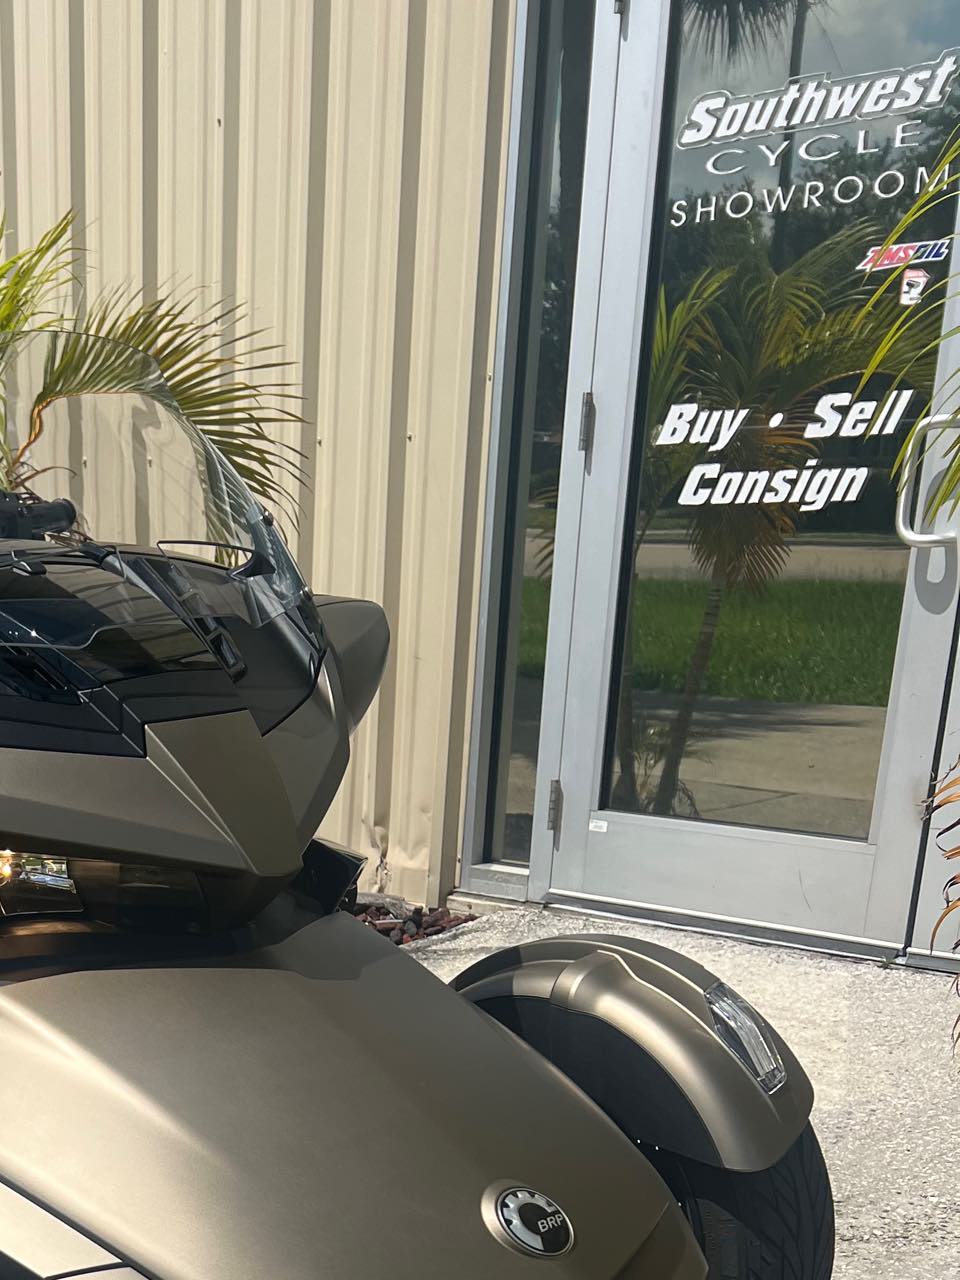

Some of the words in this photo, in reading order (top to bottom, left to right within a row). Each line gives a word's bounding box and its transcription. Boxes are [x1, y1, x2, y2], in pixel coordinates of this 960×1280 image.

[680, 55, 958, 145] Southwest
[705, 119, 923, 176] CYCLE
[670, 163, 951, 228] SHOWROOM
[856, 240, 951, 272] AMSOIL
[655, 402, 750, 452] Buy
[803, 388, 914, 439] Sell
[677, 458, 870, 512] Consign
[537, 1213, 565, 1233] BRP
